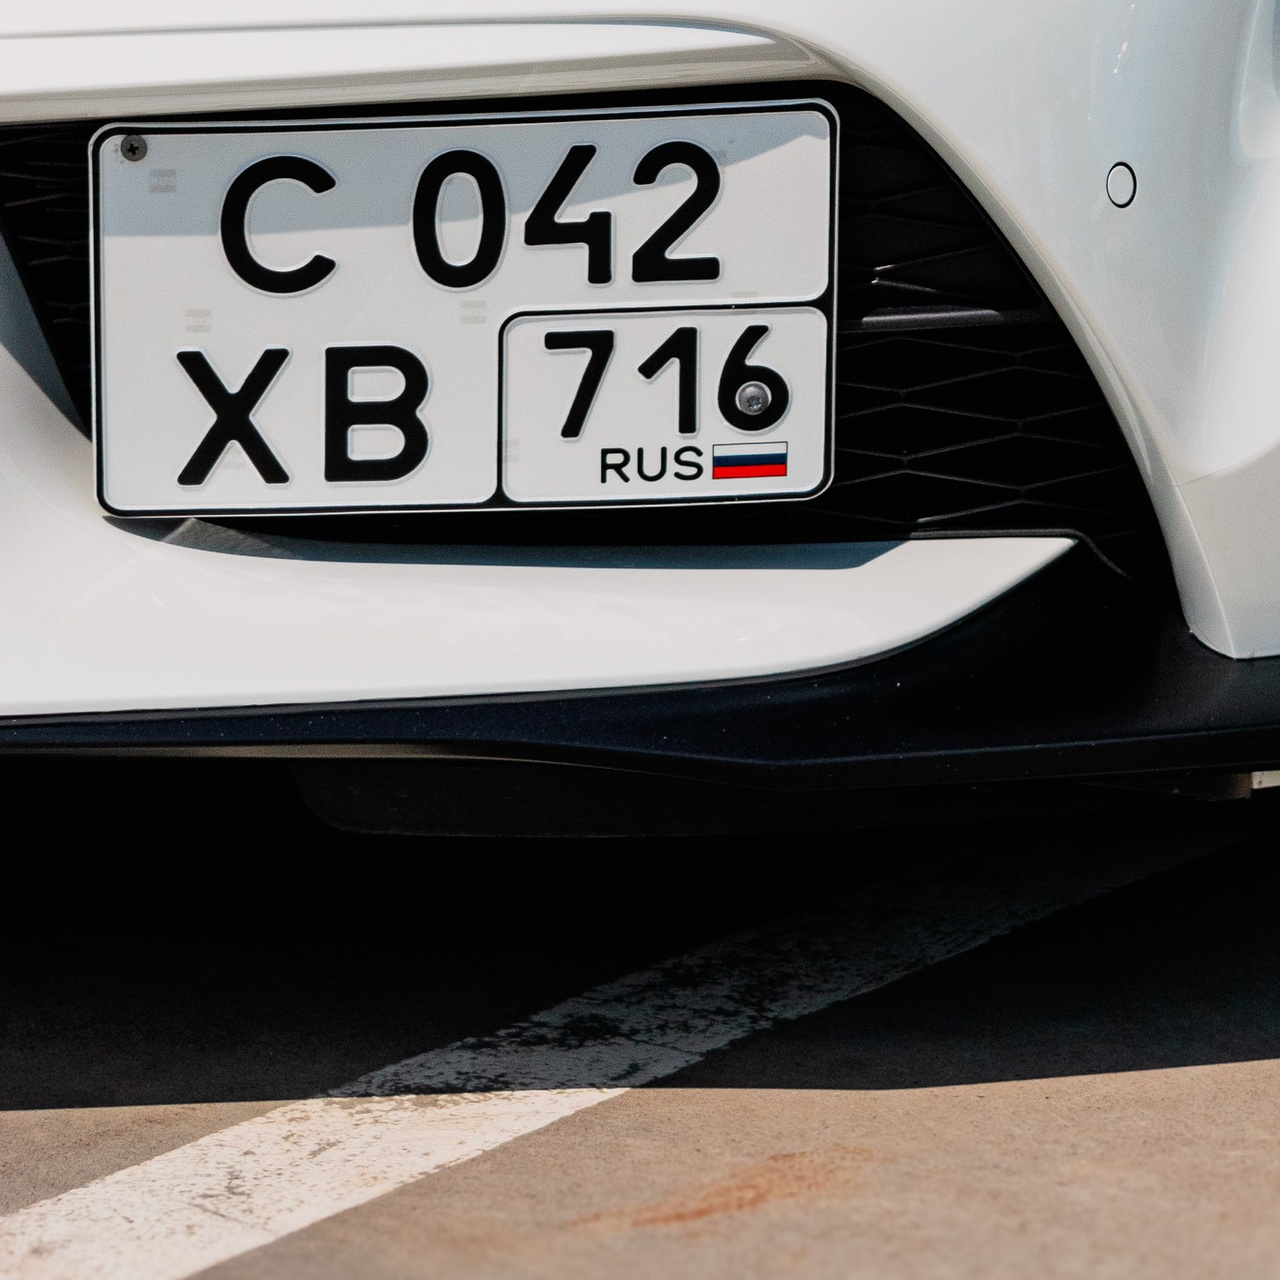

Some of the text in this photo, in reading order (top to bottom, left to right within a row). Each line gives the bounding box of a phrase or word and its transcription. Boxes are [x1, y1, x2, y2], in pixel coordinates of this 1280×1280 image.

[412, 141, 721, 289] 042
[544, 325, 790, 439] 716
[600, 445, 704, 484] RUS
